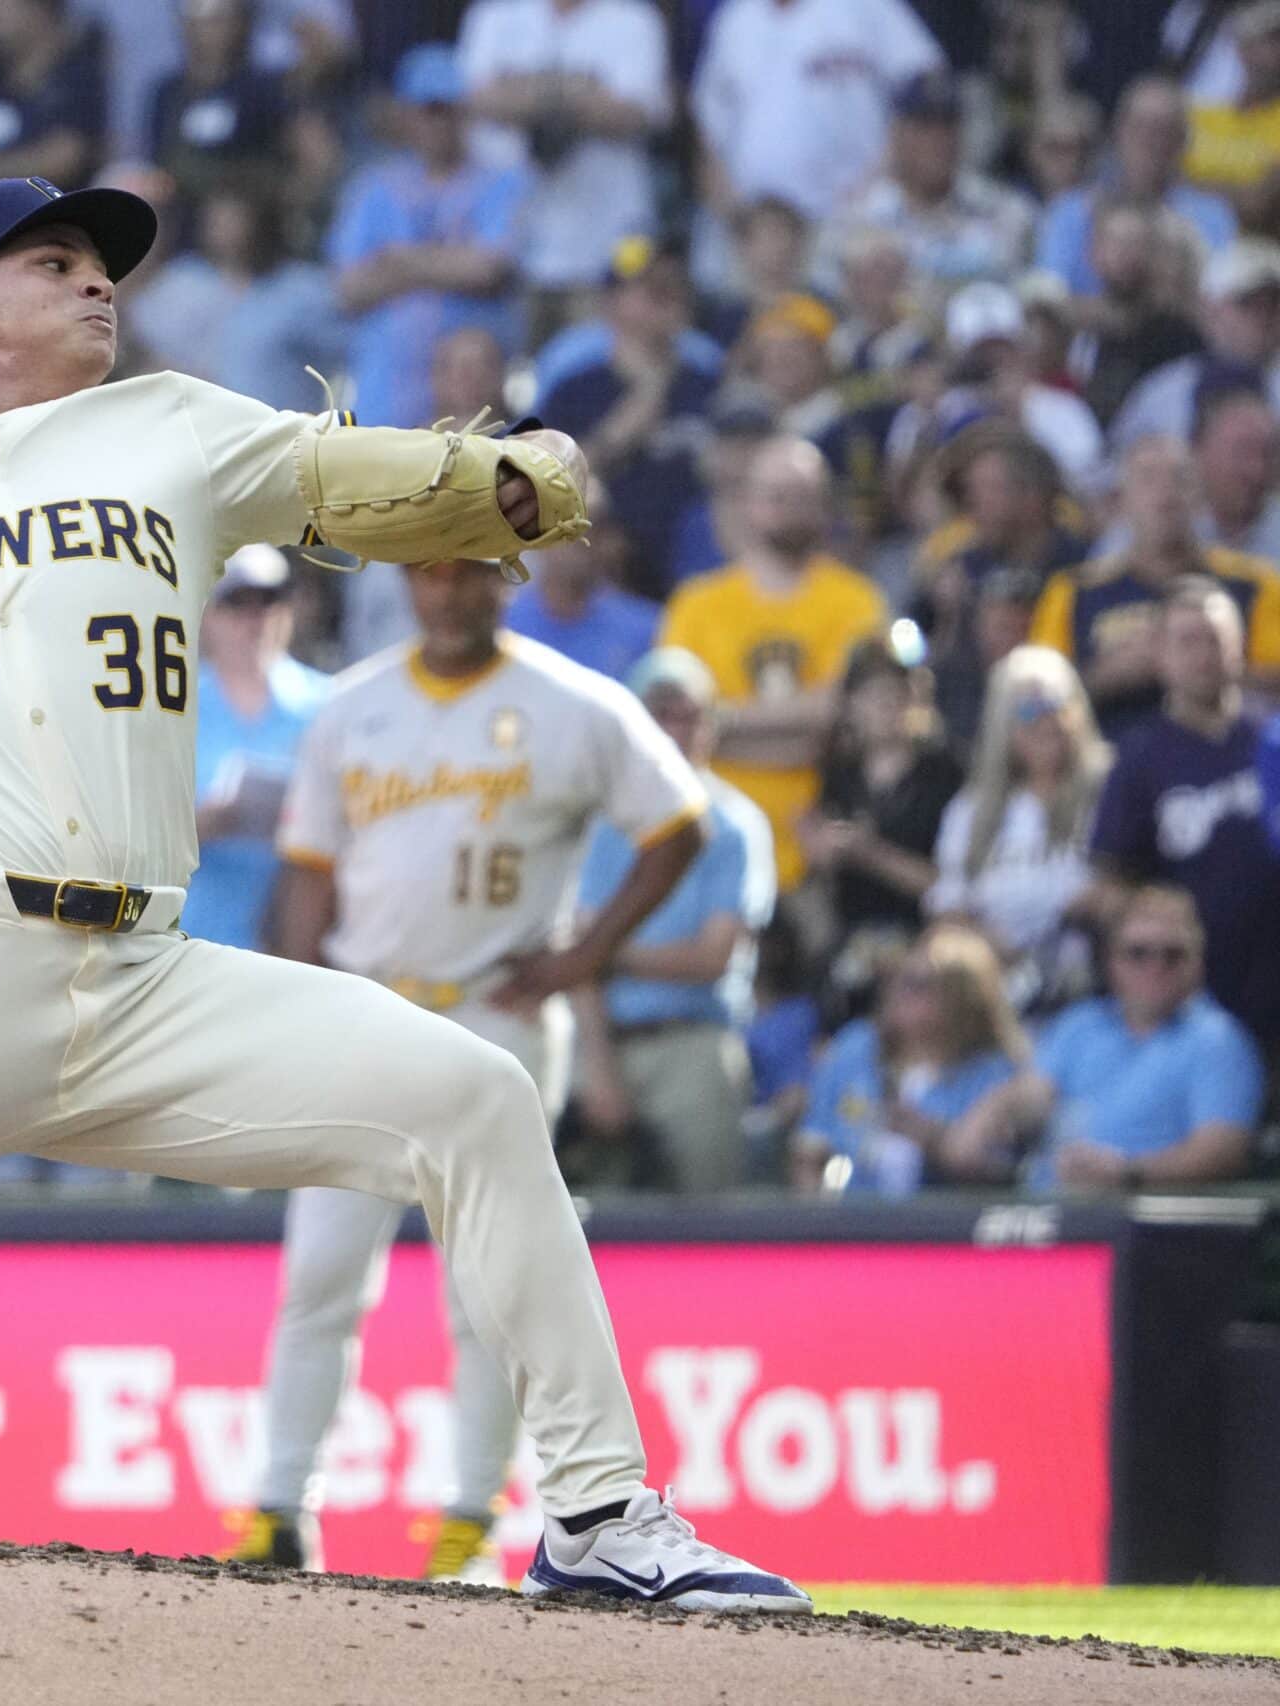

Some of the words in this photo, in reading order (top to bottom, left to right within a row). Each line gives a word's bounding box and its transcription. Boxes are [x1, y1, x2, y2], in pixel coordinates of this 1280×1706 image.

[86, 612, 187, 715] 36
[453, 842, 526, 906] 16
[57, 1343, 543, 1547] Ever
[646, 1344, 997, 1513] You.
